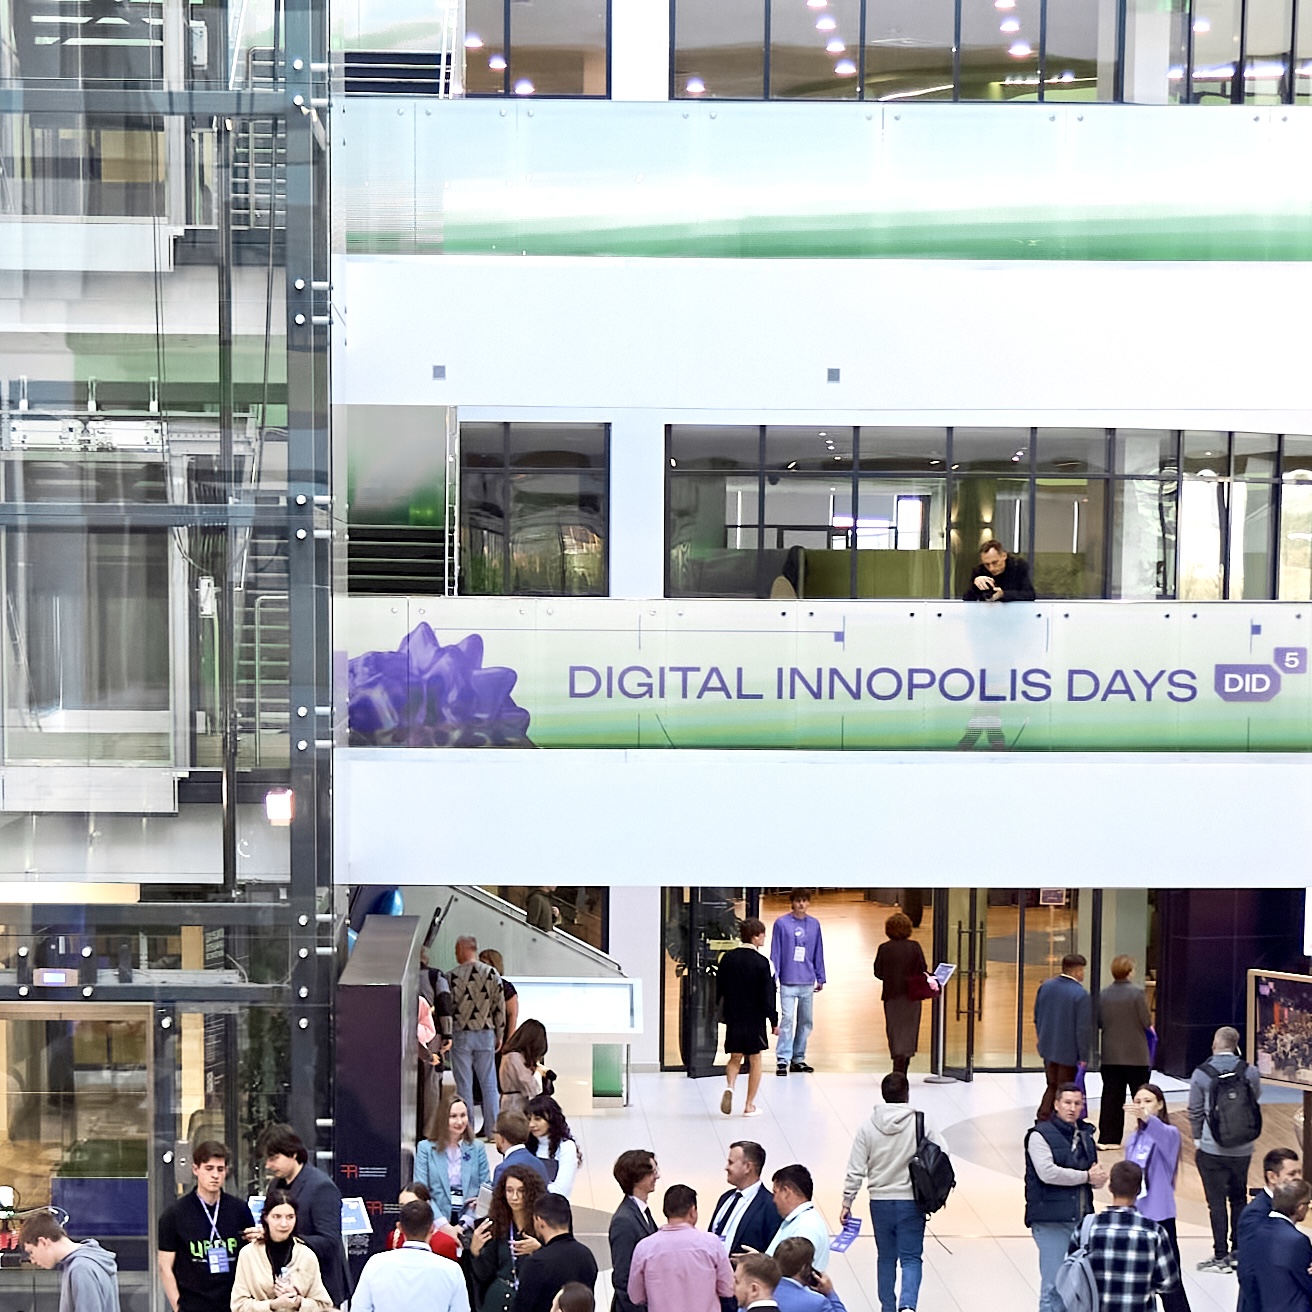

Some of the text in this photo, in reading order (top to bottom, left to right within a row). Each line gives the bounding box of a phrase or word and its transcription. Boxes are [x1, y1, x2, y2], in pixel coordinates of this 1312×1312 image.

[1283, 651, 1300, 669] 5
[568, 665, 1271, 702] DIGITAL INNOPOLIS DAYS DID
